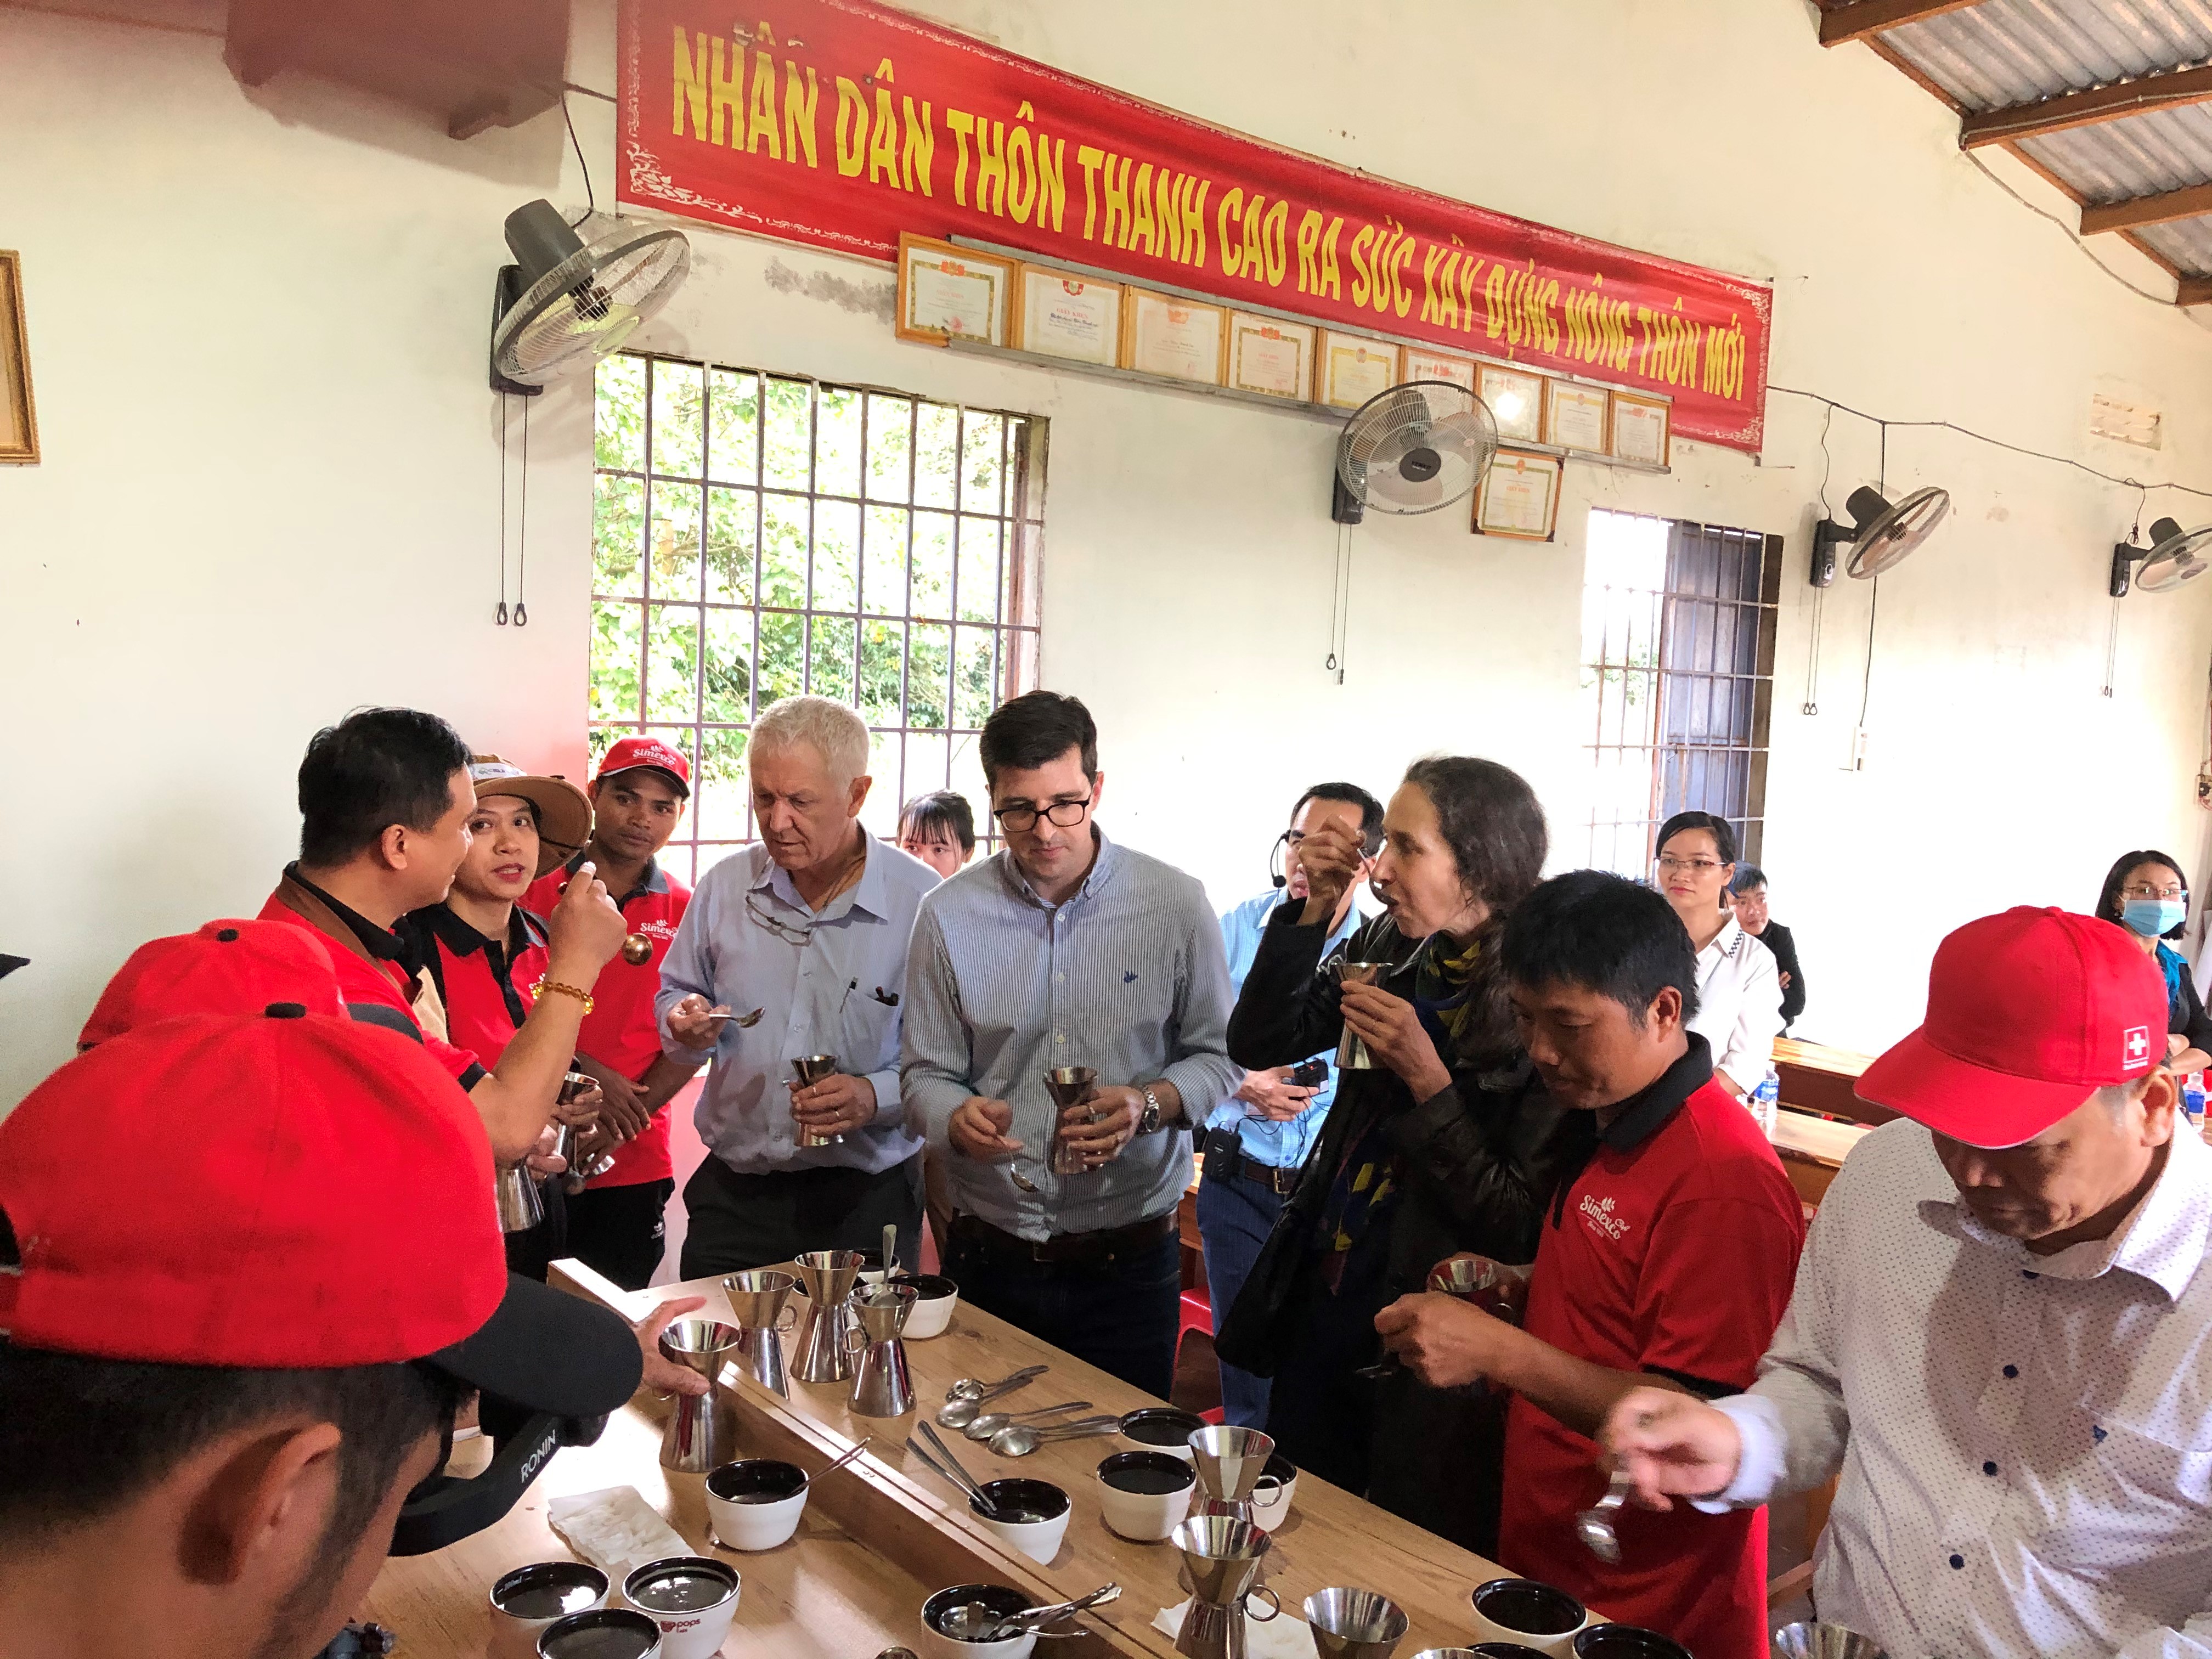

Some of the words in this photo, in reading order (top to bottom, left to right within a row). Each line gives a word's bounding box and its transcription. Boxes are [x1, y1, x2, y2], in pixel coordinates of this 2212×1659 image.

[673, 21, 819, 168] NHÂN
[835, 58, 934, 198] DÂN
[946, 101, 1065, 232] THÔN
[1077, 145, 1211, 268] THANH
[1218, 188, 1289, 287] CAO
[1297, 209, 1344, 301] RA
[1485, 258, 1559, 360] DỰNG
[1565, 272, 1634, 373] NÔNG
[1637, 296, 1701, 389] THÔN
[1703, 313, 1746, 401] MỚI
[633, 748, 675, 765] Simexco
[1579, 1194, 1621, 1239] Simexco
[521, 1429, 556, 1483] RONIN
[677, 1618, 701, 1627] pops
